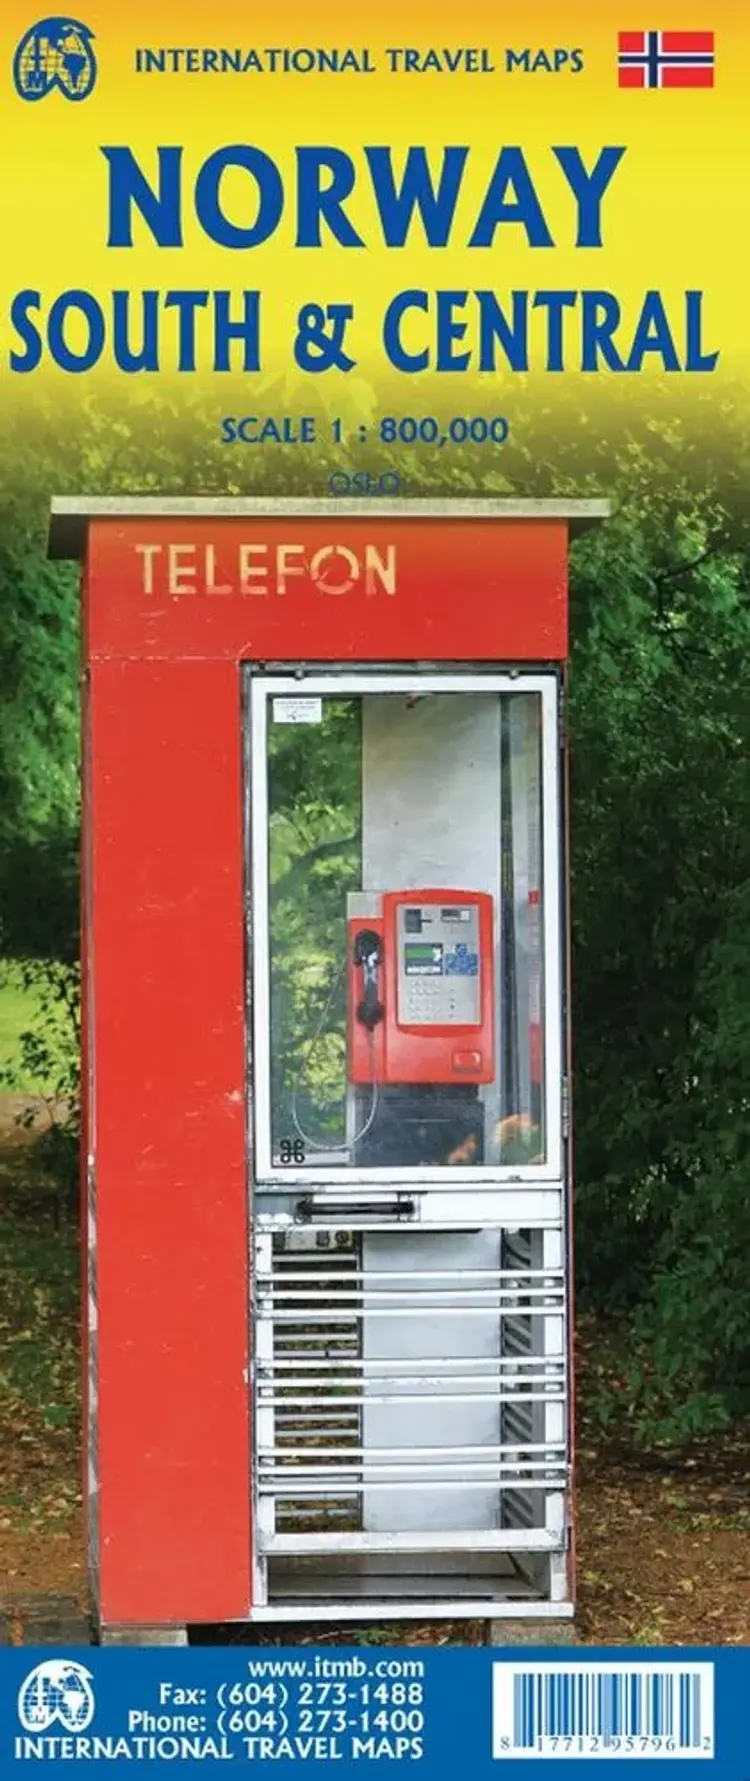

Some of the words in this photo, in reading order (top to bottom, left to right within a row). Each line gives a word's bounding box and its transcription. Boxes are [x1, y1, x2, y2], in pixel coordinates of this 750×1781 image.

[135, 48, 376, 73] INTERNATIONAL
[385, 48, 495, 73] TRAVEL
[506, 48, 584, 73] MAPS
[100, 144, 626, 250] NORWAY
[10, 289, 260, 373] SOUTH
[294, 303, 356, 372] &
[383, 289, 719, 373] CENTRAL
[221, 417, 315, 444] SCALE
[332, 417, 344, 443] 1
[380, 416, 510, 448] 800,000
[135, 544, 396, 596] TELEFON
[248, 1656, 424, 1678] www.itmb.com
[160, 1683, 206, 1705] Fax:
[217, 1683, 288, 1708] (604)
[298, 1682, 423, 1706] 273-1488
[128, 1710, 206, 1733] Phone:
[217, 1709, 288, 1736] (604)
[298, 1709, 424, 1733] 273-1400
[15, 1736, 233, 1759] INTERNATIONAL
[243, 1737, 343, 1759] TRAVEL
[352, 1737, 423, 1759] MAPS
